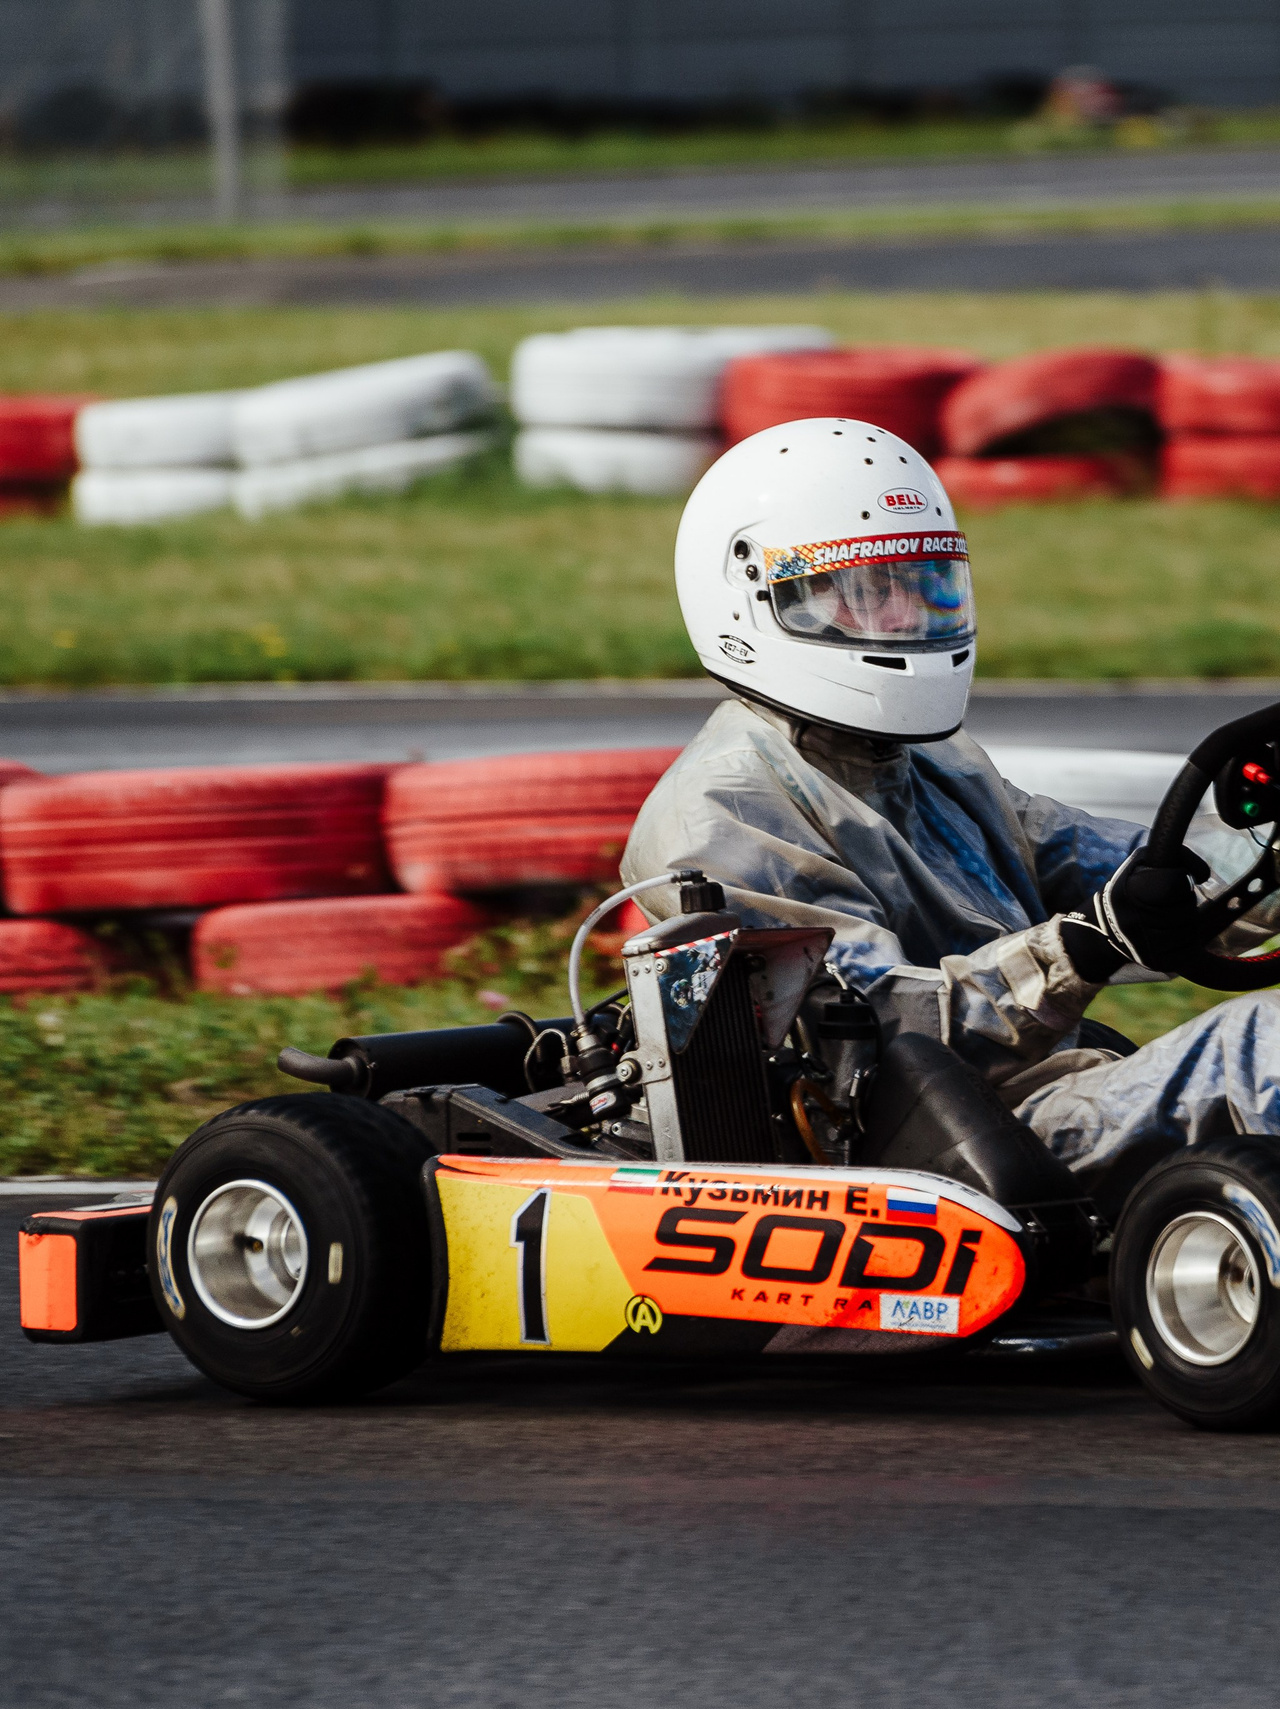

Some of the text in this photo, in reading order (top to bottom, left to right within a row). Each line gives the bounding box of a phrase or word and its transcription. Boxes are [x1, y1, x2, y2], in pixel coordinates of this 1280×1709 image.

[884, 493, 924, 507] BELL
[813, 537, 920, 567] SHAFRANOV
[922, 537, 953, 553] RACE
[661, 1170, 830, 1211] Кузьмин
[509, 1187, 551, 1345] 1
[731, 1288, 814, 1307] KART
